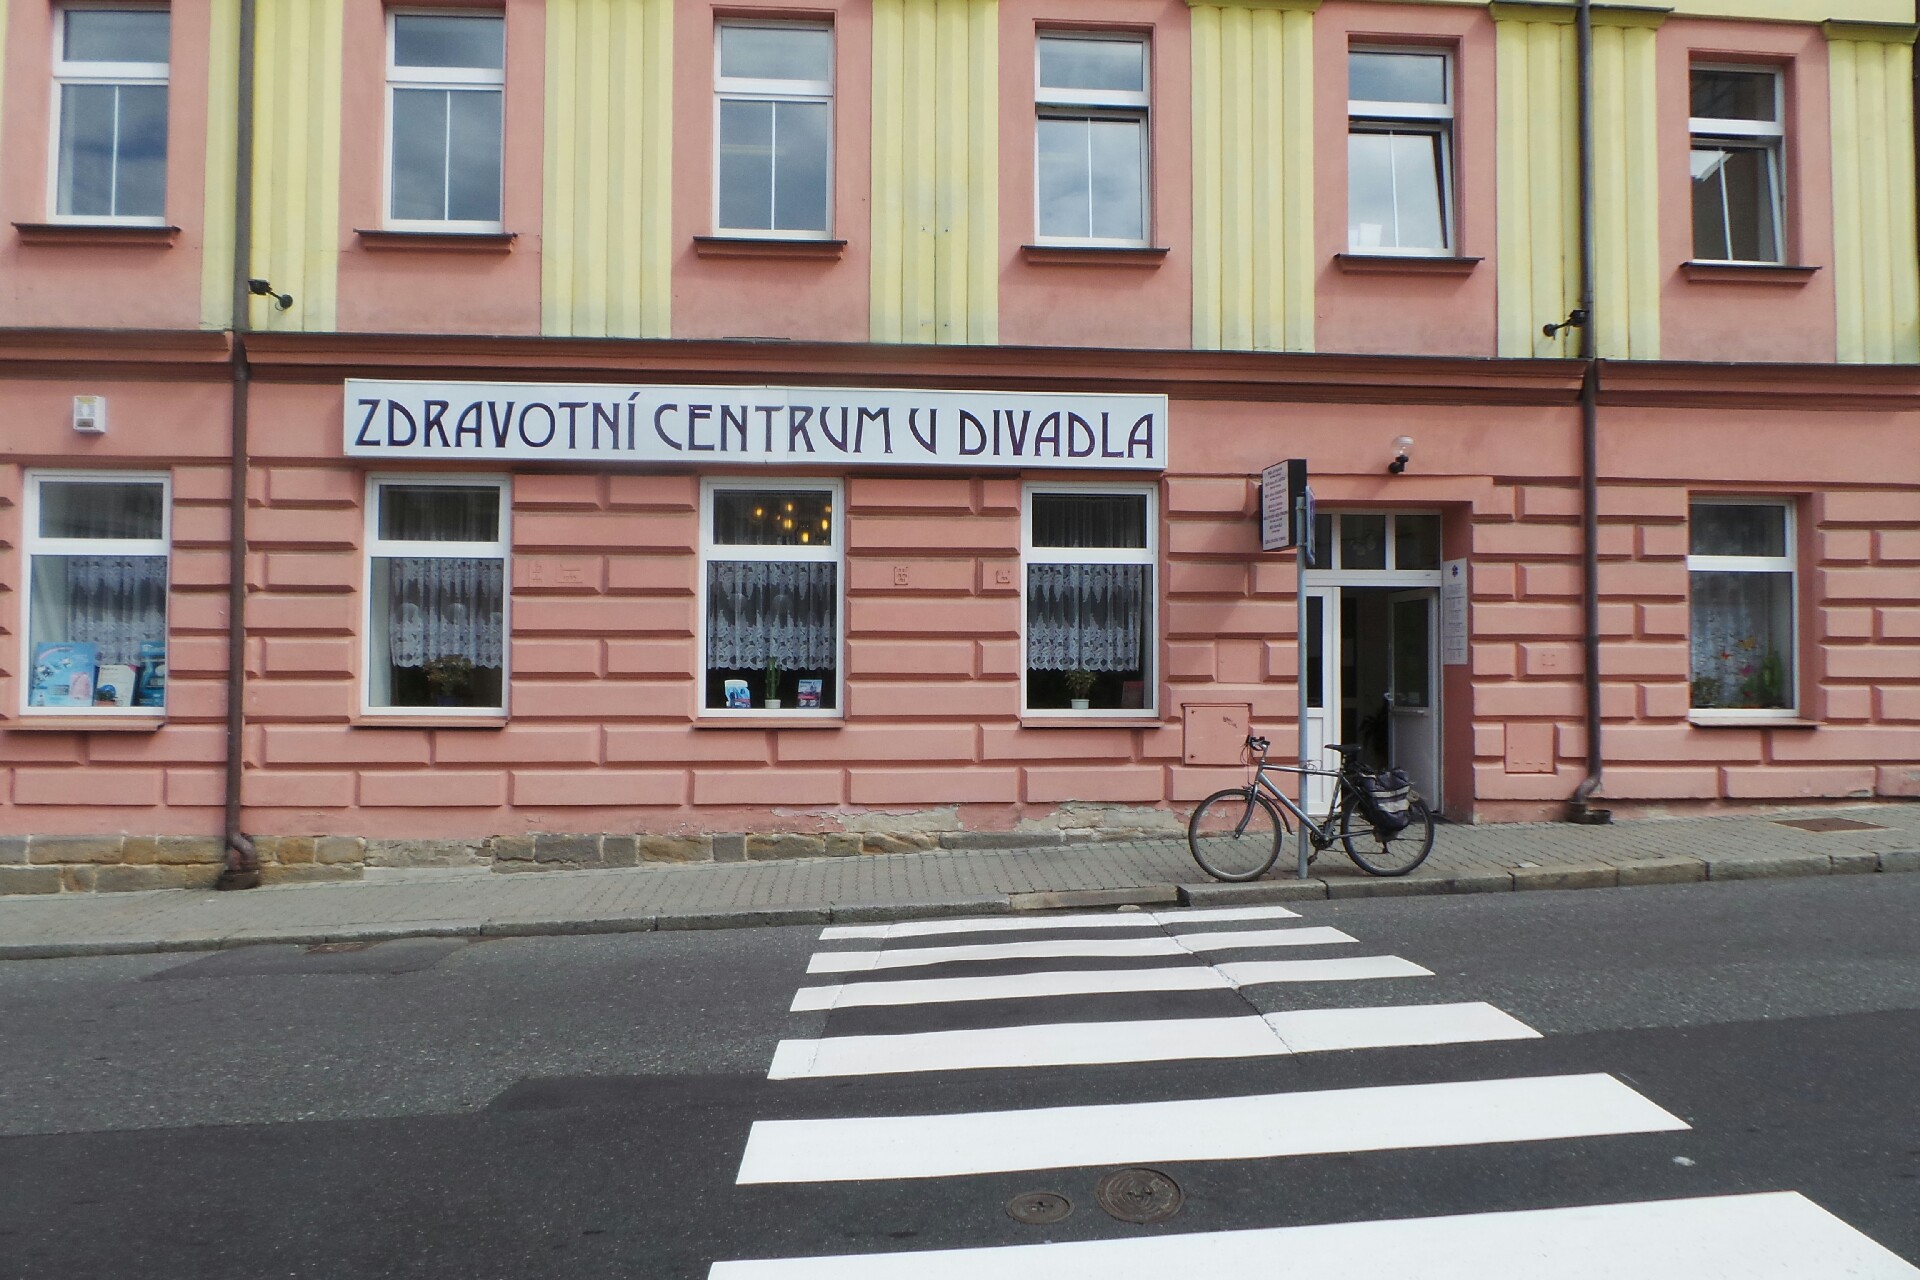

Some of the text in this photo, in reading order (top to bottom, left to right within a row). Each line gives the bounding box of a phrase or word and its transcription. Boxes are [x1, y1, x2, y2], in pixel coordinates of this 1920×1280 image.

[355, 391, 1154, 459] ZDRAVOTNÍ CENTRUM U DIVADLA
